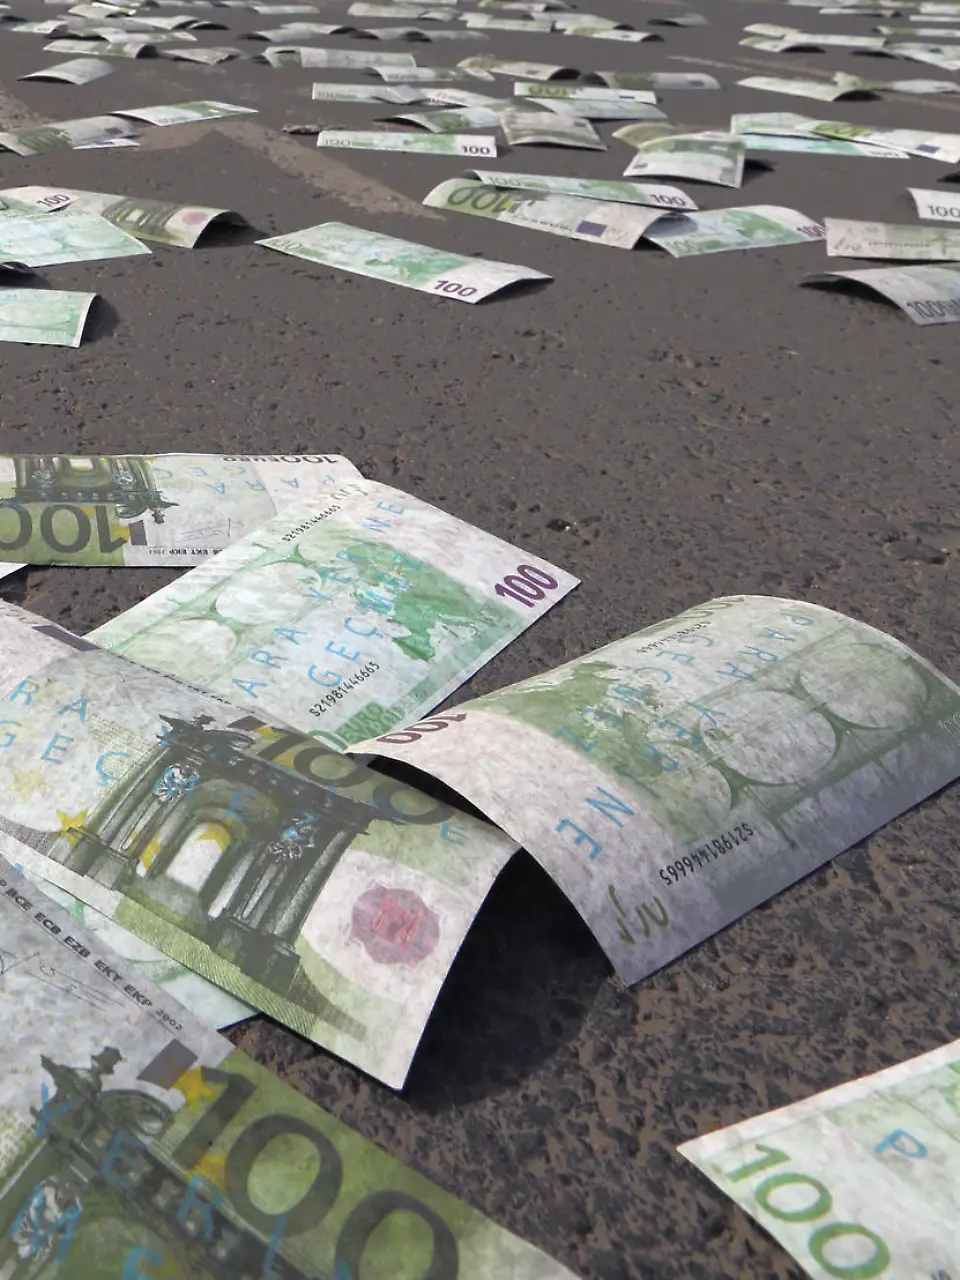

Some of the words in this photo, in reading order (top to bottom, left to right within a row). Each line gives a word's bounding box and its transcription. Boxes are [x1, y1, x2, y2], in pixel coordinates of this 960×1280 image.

[461, 145, 491, 155] 100
[37, 193, 71, 208] 100
[651, 193, 685, 206] 100
[433, 279, 479, 297] 100
[906, 300, 946, 318] 100
[494, 564, 559, 609] 100
[232, 627, 308, 698] ARA
[309, 661, 380, 717] S21981446665
[376, 713, 468, 745] 100
[658, 822, 755, 887] S21981446665
[5, 887, 32, 911] BCE
[34, 911, 62, 935] ECB
[63, 935, 91, 959] EZB
[94, 959, 124, 984] EKT
[123, 984, 153, 1008] EKP
[173, 1064, 459, 1280] 100
[726, 1143, 891, 1280] 100
